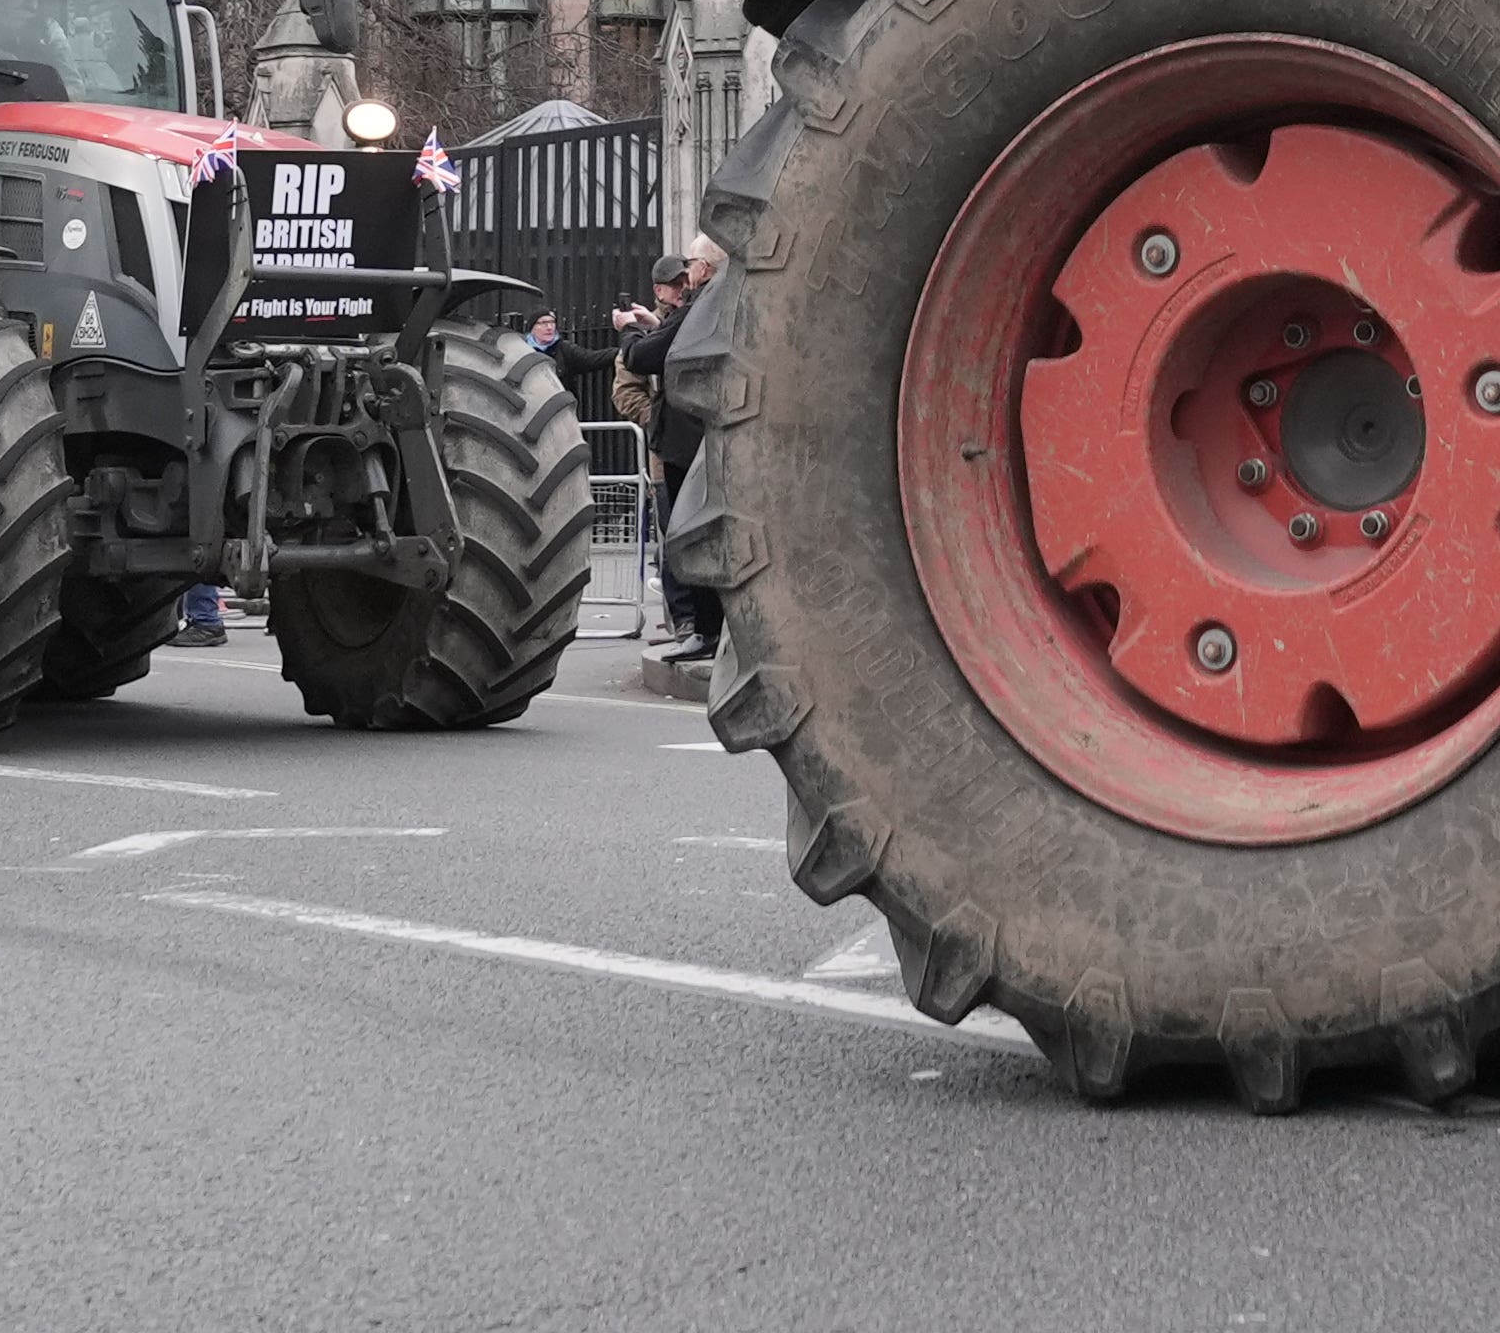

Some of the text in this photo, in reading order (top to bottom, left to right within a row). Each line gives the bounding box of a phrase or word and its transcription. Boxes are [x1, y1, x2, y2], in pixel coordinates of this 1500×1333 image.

[18, 141, 70, 164] FERGUSON
[271, 163, 346, 215] RIP
[255, 219, 353, 249] BRITISH
[251, 298, 288, 318] Fight
[305, 298, 337, 317] Your
[338, 297, 373, 318] Fight
